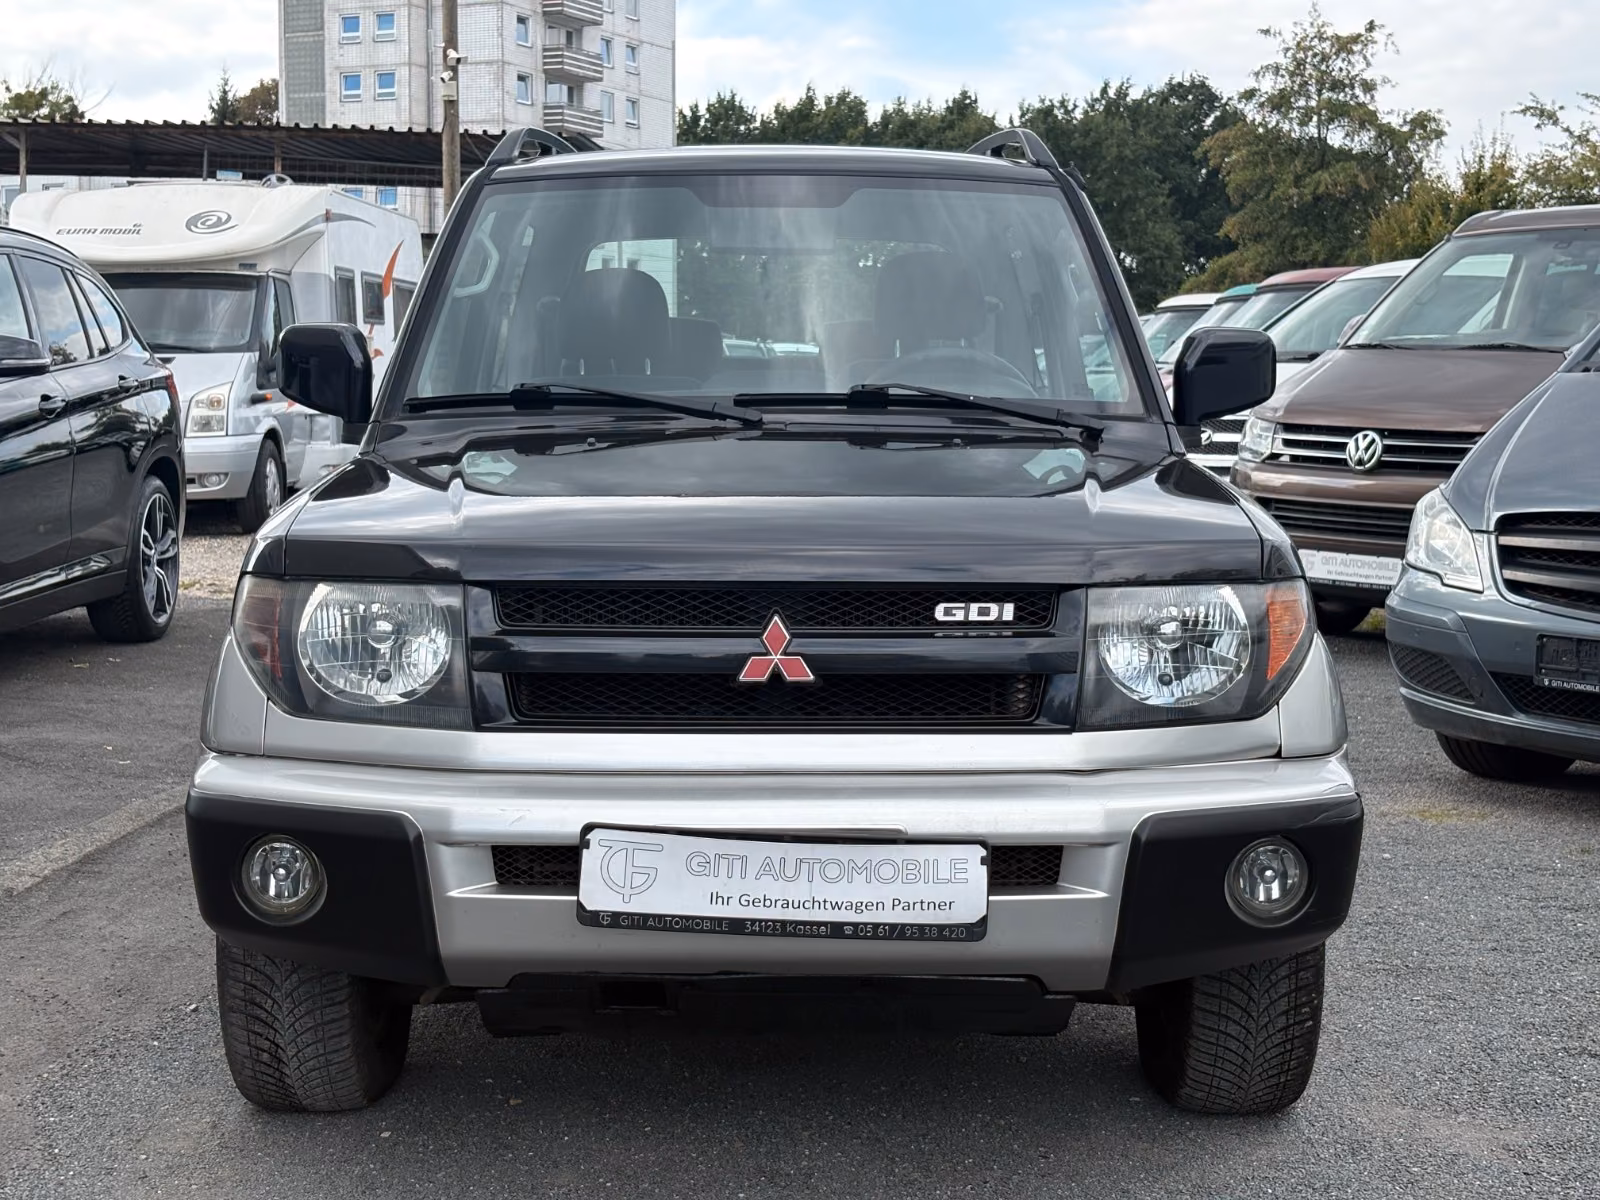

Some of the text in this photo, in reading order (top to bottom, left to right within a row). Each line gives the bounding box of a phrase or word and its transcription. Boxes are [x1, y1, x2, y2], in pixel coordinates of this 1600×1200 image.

[1339, 558, 1398, 573] AUTOMOBILE
[934, 602, 1015, 621] GDI
[1551, 679, 1600, 692] GITI AUTOMOBILE
[685, 851, 969, 885] GITI AUTOMOBILE
[710, 891, 955, 915] Ihr Gebrauchtwagen Partner
[619, 915, 643, 927] GITI
[646, 919, 729, 931] AUTOMOBILE
[744, 921, 782, 934] 34123
[786, 923, 831, 936] Kassel
[857, 924, 873, 937] 05
[877, 925, 889, 937] 61
[904, 926, 919, 938] 95
[923, 926, 938, 938] 38
[942, 926, 966, 939] 420
